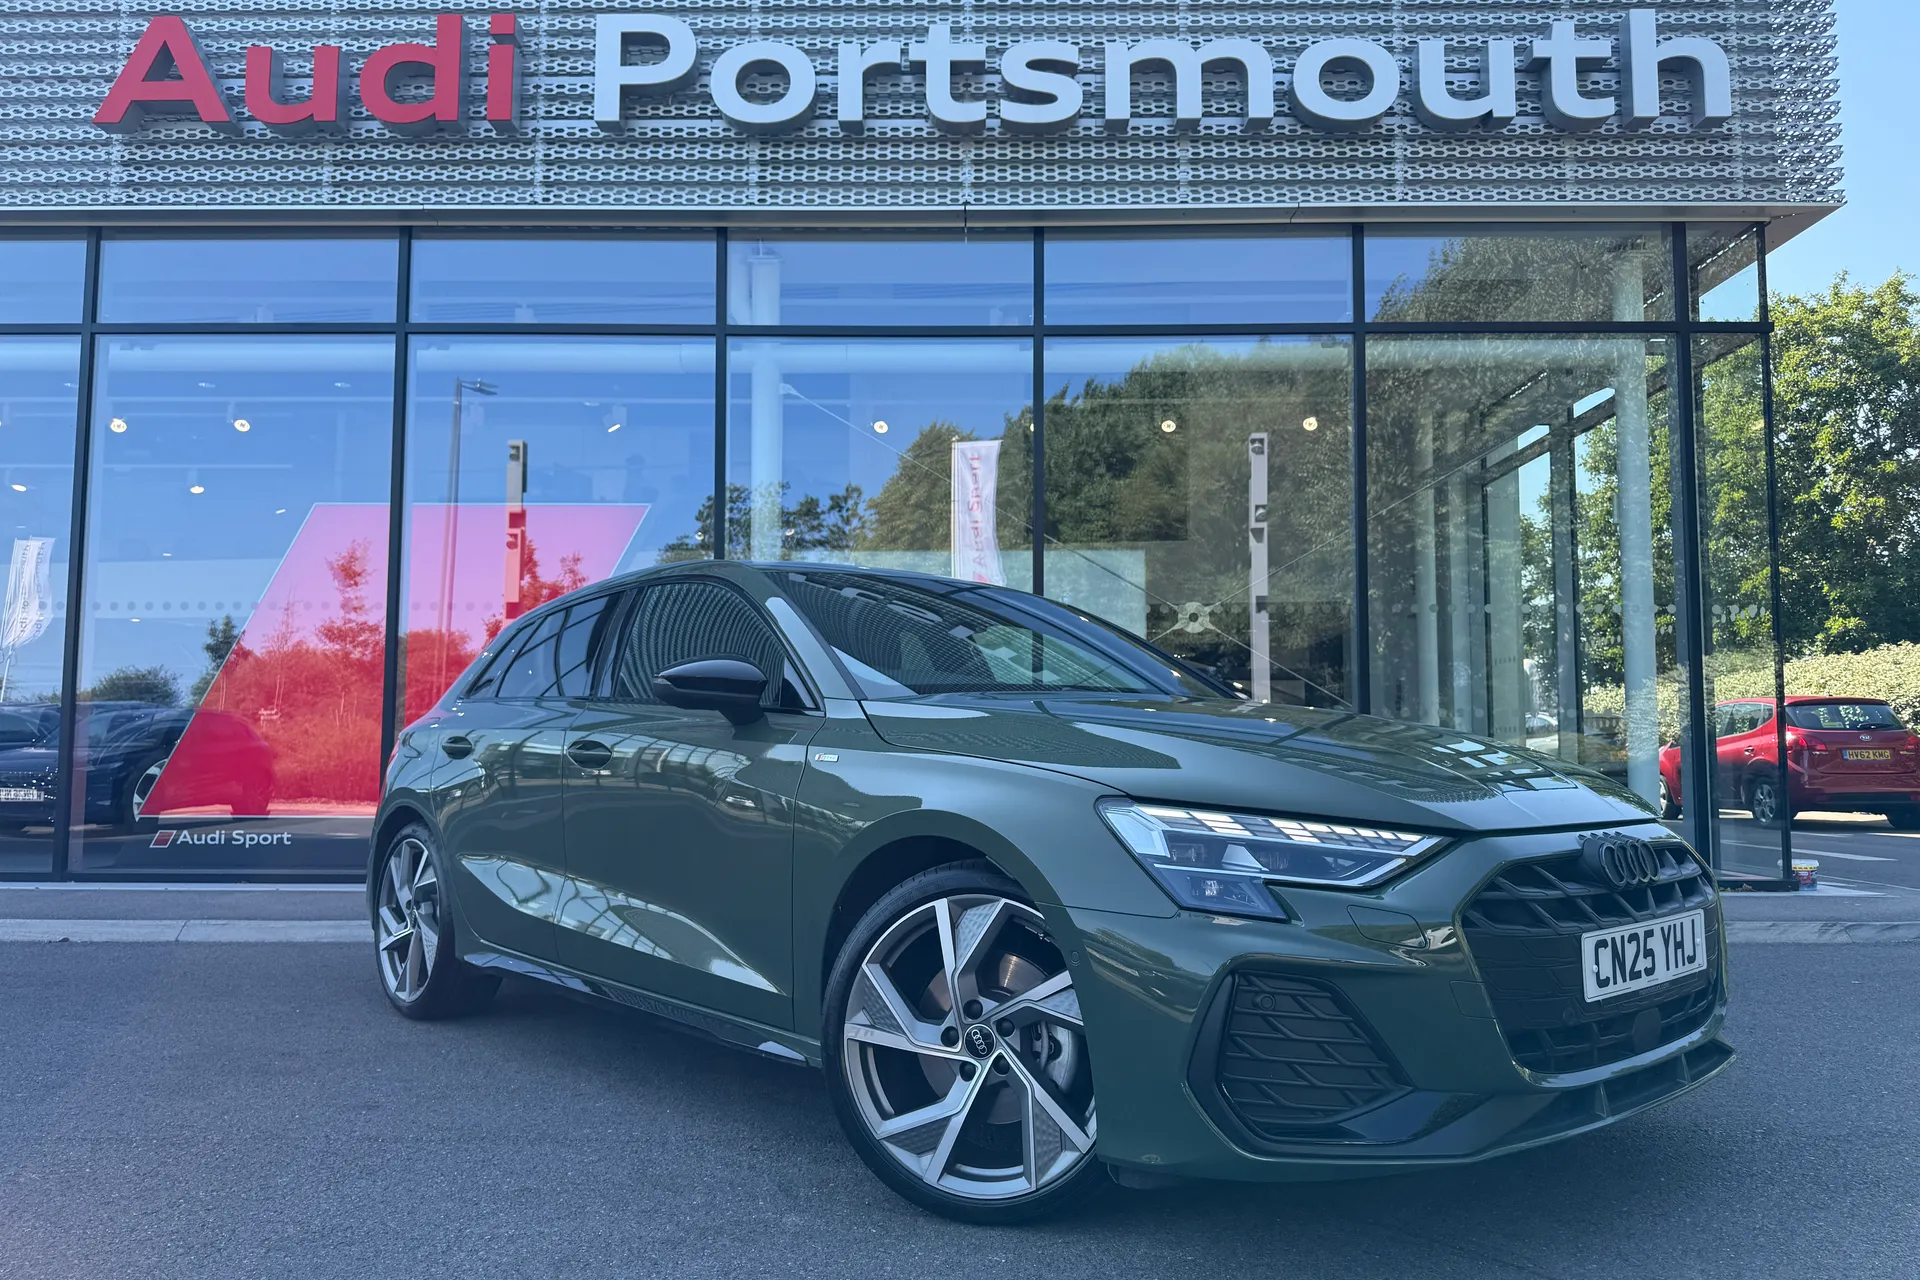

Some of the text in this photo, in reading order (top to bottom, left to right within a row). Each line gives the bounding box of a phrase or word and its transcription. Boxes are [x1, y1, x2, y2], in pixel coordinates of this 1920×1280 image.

[91, 8, 1733, 130] Audi Portsmouth
[1848, 750, 1871, 759] HV62
[1872, 750, 1890, 760] KMG
[176, 829, 292, 848] Audi Sport
[1594, 918, 1697, 989] CN25 YHJ
